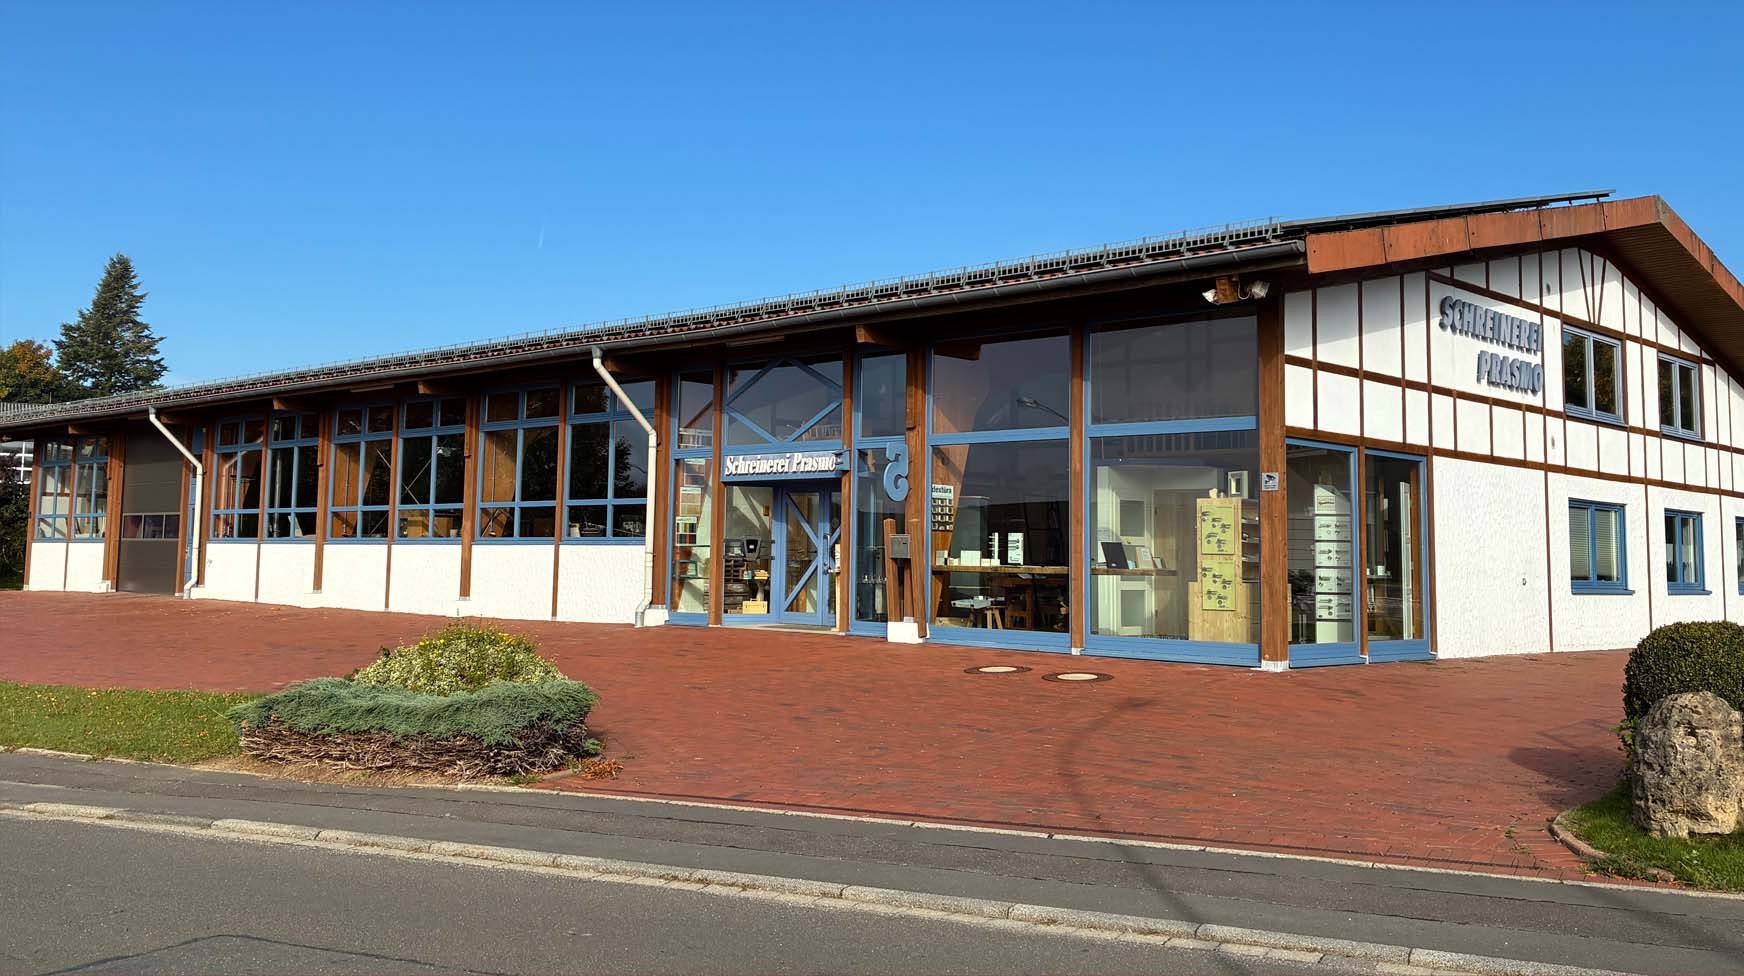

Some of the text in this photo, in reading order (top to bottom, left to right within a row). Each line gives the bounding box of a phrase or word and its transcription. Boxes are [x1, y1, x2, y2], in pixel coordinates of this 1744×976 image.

[1439, 295, 1543, 356] SCHREINEREI
[1477, 350, 1543, 397] PRASMO
[725, 452, 836, 476] Schreinerei Prasmo
